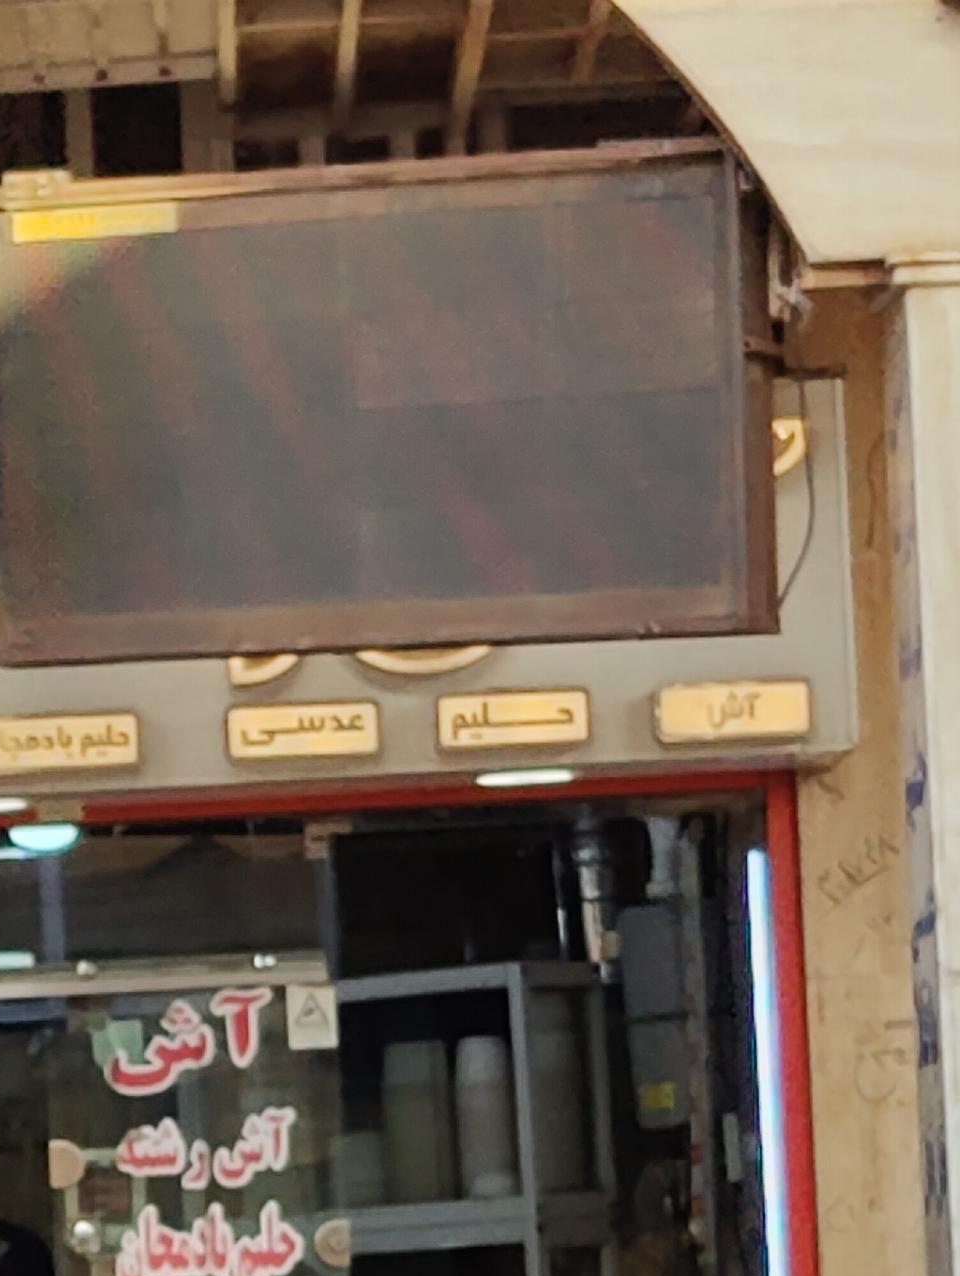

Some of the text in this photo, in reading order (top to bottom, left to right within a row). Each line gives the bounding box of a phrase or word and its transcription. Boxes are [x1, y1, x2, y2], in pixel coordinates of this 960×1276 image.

[239, 712, 366, 746] عدسی
[450, 700, 575, 740] حلیم
[704, 690, 763, 730] آش
[80, 724, 130, 758] حلیم
[105, 988, 271, 1095] آش
[116, 1107, 296, 1189] آش رشته
